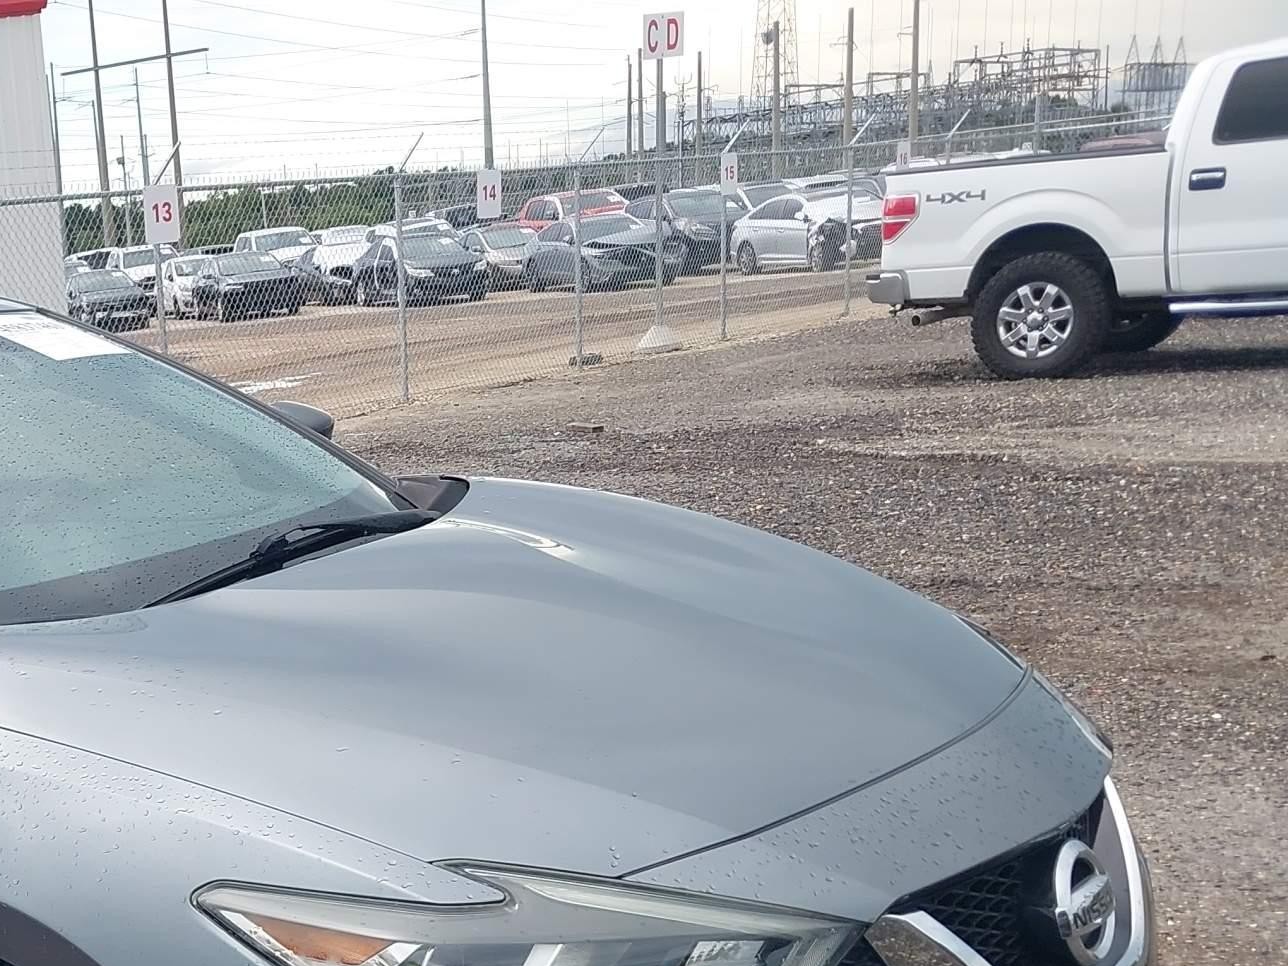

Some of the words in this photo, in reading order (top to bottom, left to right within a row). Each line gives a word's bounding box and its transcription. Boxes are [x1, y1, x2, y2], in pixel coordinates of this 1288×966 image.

[647, 18, 659, 53] C
[666, 18, 679, 51] D
[725, 165, 735, 181] 15
[482, 184, 497, 201] 14
[152, 202, 172, 223] 13
